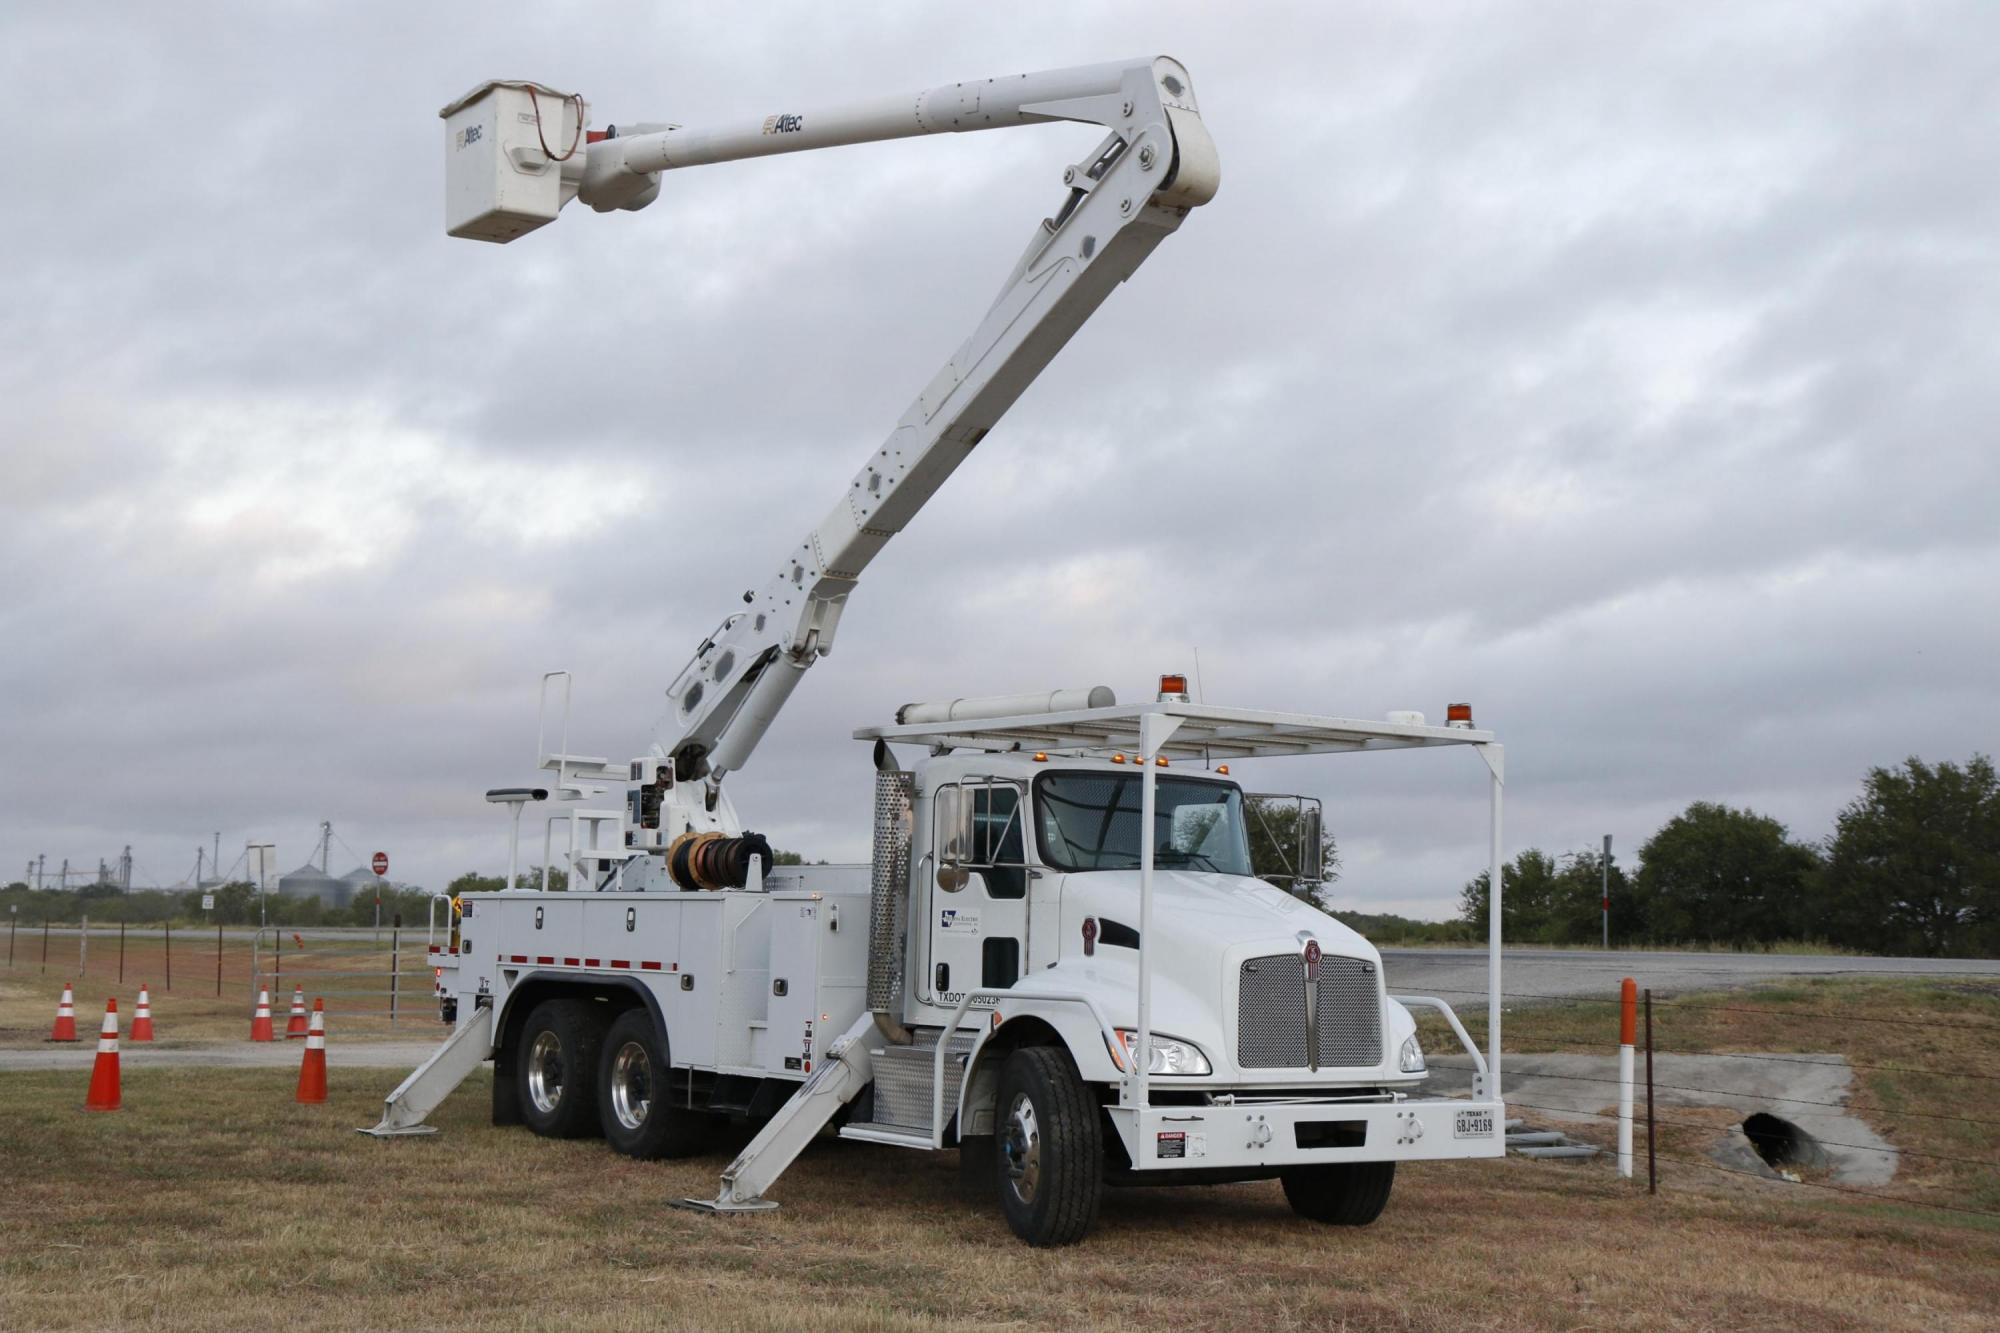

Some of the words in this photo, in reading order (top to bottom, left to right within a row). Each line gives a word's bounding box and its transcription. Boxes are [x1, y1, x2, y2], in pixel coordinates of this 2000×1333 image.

[774, 113, 803, 134] Altec
[464, 124, 482, 148] Altec
[938, 992, 967, 1003] TXDOT
